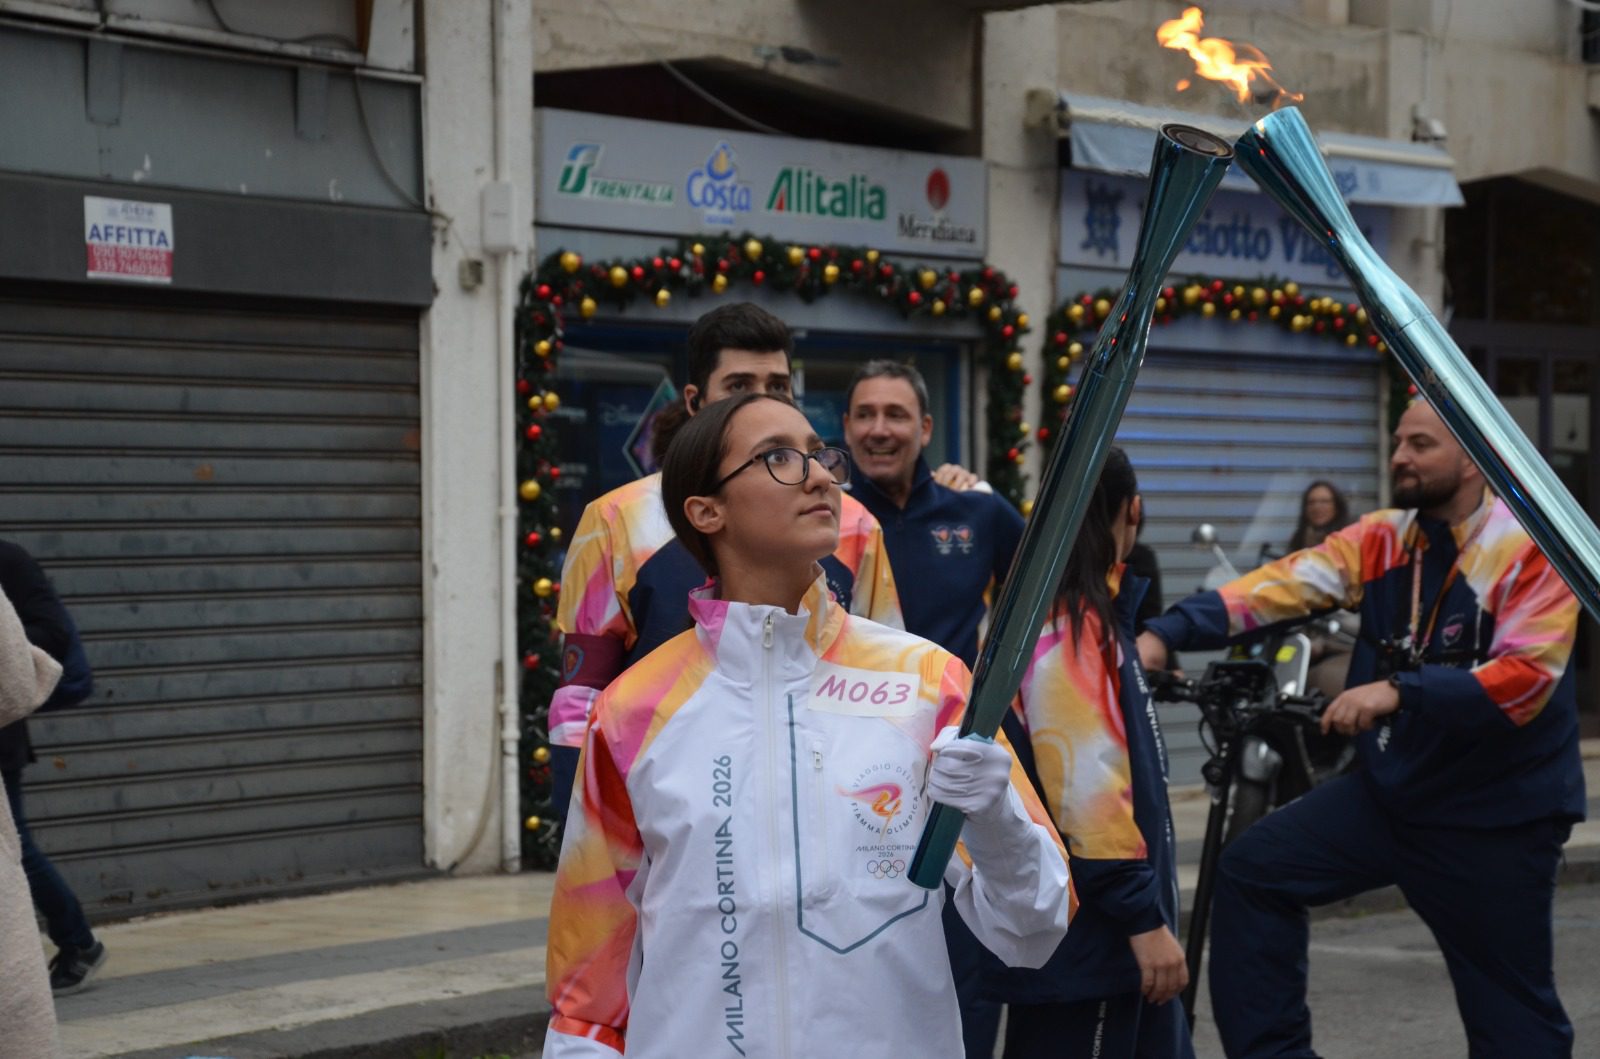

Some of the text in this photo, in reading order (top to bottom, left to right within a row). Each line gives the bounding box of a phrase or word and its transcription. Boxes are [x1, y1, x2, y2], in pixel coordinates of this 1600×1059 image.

[590, 179, 674, 203] TRENITALIA
[687, 169, 751, 212] Costa
[766, 167, 886, 220] Alitalia
[88, 223, 169, 247] AFFITTA
[898, 212, 976, 243] Meridiana
[851, 796, 919, 835] FIAMMA OLIMPICA
[712, 755, 746, 1058] MILANO CORTINA 2026
